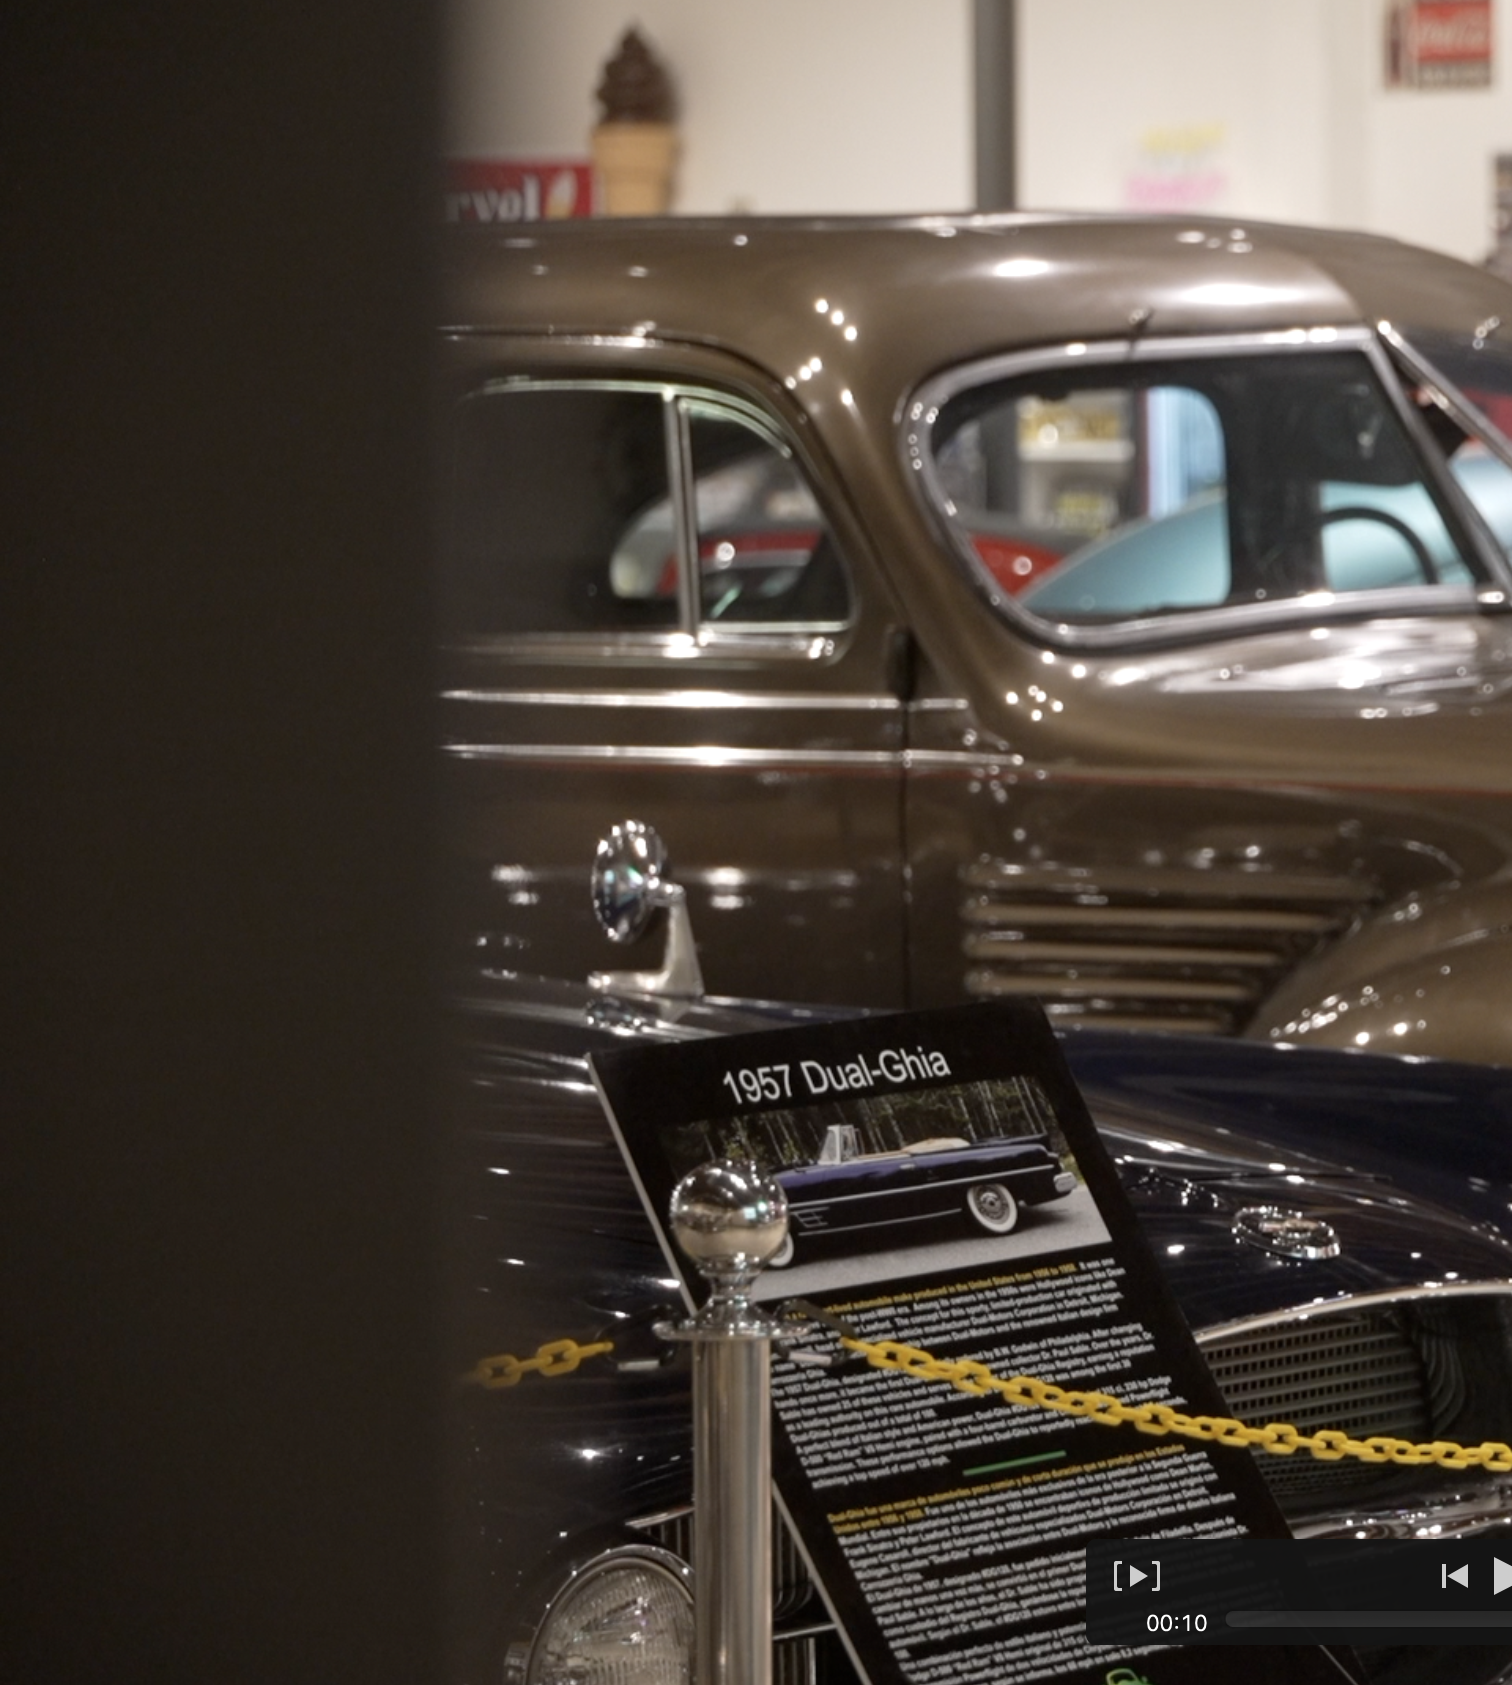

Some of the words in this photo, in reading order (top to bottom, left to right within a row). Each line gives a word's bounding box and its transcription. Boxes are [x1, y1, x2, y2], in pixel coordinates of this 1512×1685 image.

[722, 1063, 794, 1106] 1957
[799, 1047, 951, 1094] Dual-Ghia
[846, 1313, 858, 1322] the
[897, 1305, 909, 1313] era.
[911, 1299, 938, 1313] Among
[938, 1297, 948, 1306] its
[949, 1294, 976, 1304] owners
[975, 1291, 983, 1299] in
[984, 1288, 996, 1298] the
[997, 1285, 1018, 1295] 1950s
[1019, 1283, 1035, 1292] were
[1035, 1275, 1073, 1291] Hollywood
[1073, 1271, 1092, 1282] icons
[1092, 1269, 1105, 1278] like
[1106, 1266, 1125, 1276] Dean
[851, 1295, 891, 1309] automobile
[892, 1291, 912, 1302] make
[912, 1285, 947, 1300] produced
[947, 1284, 955, 1292] in
[955, 1281, 967, 1291] the
[968, 1277, 991, 1289] United
[992, 1273, 1014, 1284] States
[1014, 1270, 1031, 1280] from
[1049, 1266, 1057, 1274] to
[1079, 1261, 1085, 1269] It
[1086, 1260, 1099, 1268] was
[1101, 1257, 1114, 1265] one
[860, 1319, 892, 1332] Lawford.
[894, 1316, 909, 1326] The
[909, 1310, 939, 1325] concept
[938, 1308, 950, 1318] for
[950, 1306, 965, 1316] this
[965, 1302, 989, 1315] sporty,
[989, 1290, 1054, 1311] limited-production
[1054, 1289, 1065, 1297] car
[1065, 1282, 1101, 1297] originated
[1101, 1279, 1117, 1289] with
[897, 1325, 922, 1337] vehicle
[923, 1317, 970, 1333] manufacturer
[970, 1309, 1012, 1324] Dual-Motors
[1013, 1302, 1056, 1318] Corporation
[1055, 1300, 1063, 1309] in
[1063, 1296, 1089, 1307] Detroit,
[1089, 1289, 1124, 1304] Michigan.
[920, 1332, 951, 1345] between
[951, 1324, 995, 1339] Dual-Motors
[994, 1322, 1009, 1332] and
[1009, 1319, 1021, 1329] the
[1021, 1313, 1056, 1327] renowned
[1056, 1309, 1078, 1320] Italian
[1078, 1305, 1103, 1318] design
[1103, 1302, 1118, 1312] firm
